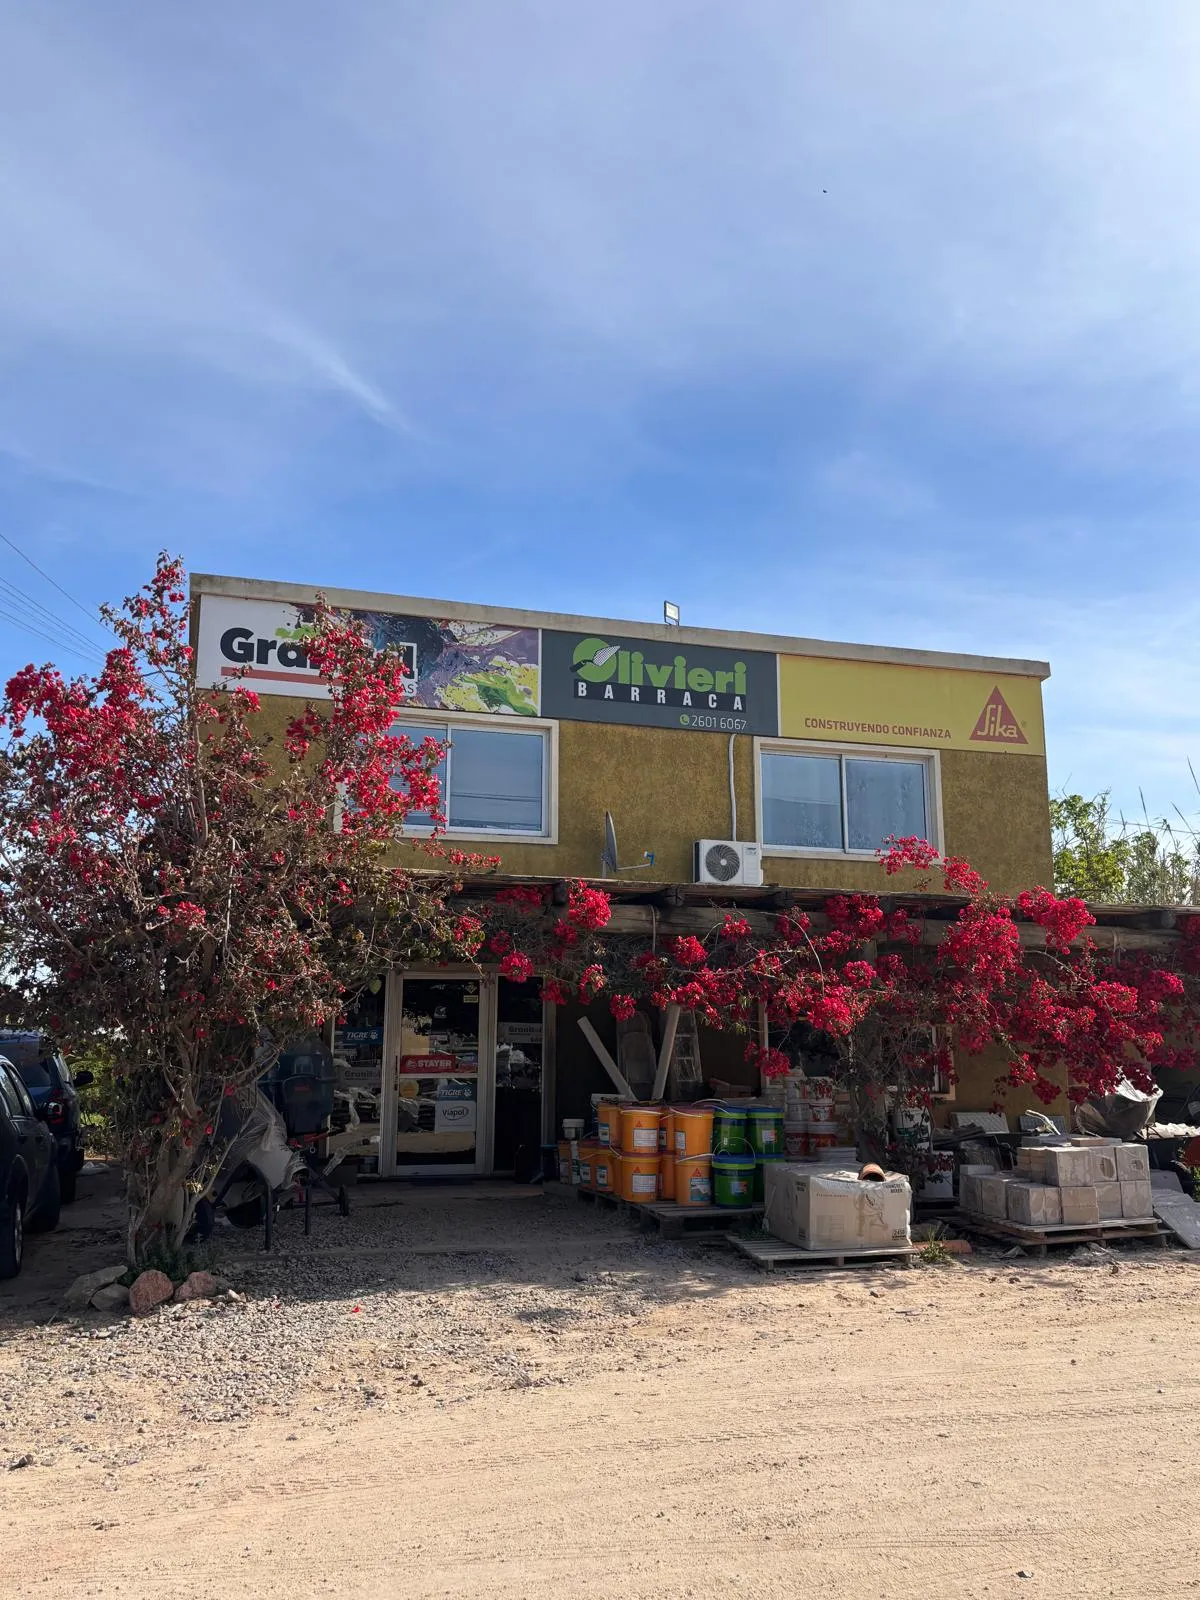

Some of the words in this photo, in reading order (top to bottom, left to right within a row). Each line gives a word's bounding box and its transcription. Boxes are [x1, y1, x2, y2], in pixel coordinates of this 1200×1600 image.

[572, 637, 747, 695] Olivieri
[577, 681, 743, 711] BARRACA
[691, 715, 717, 728] 2601
[719, 717, 747, 731] 6067
[804, 717, 890, 735] CONSTRUYENDO
[891, 725, 952, 740] CONFIANZA
[976, 704, 1018, 738] Sika
[346, 1031, 369, 1039] TIGRE
[417, 1059, 452, 1068] STAYER
[442, 1108, 465, 1118] Viapol
